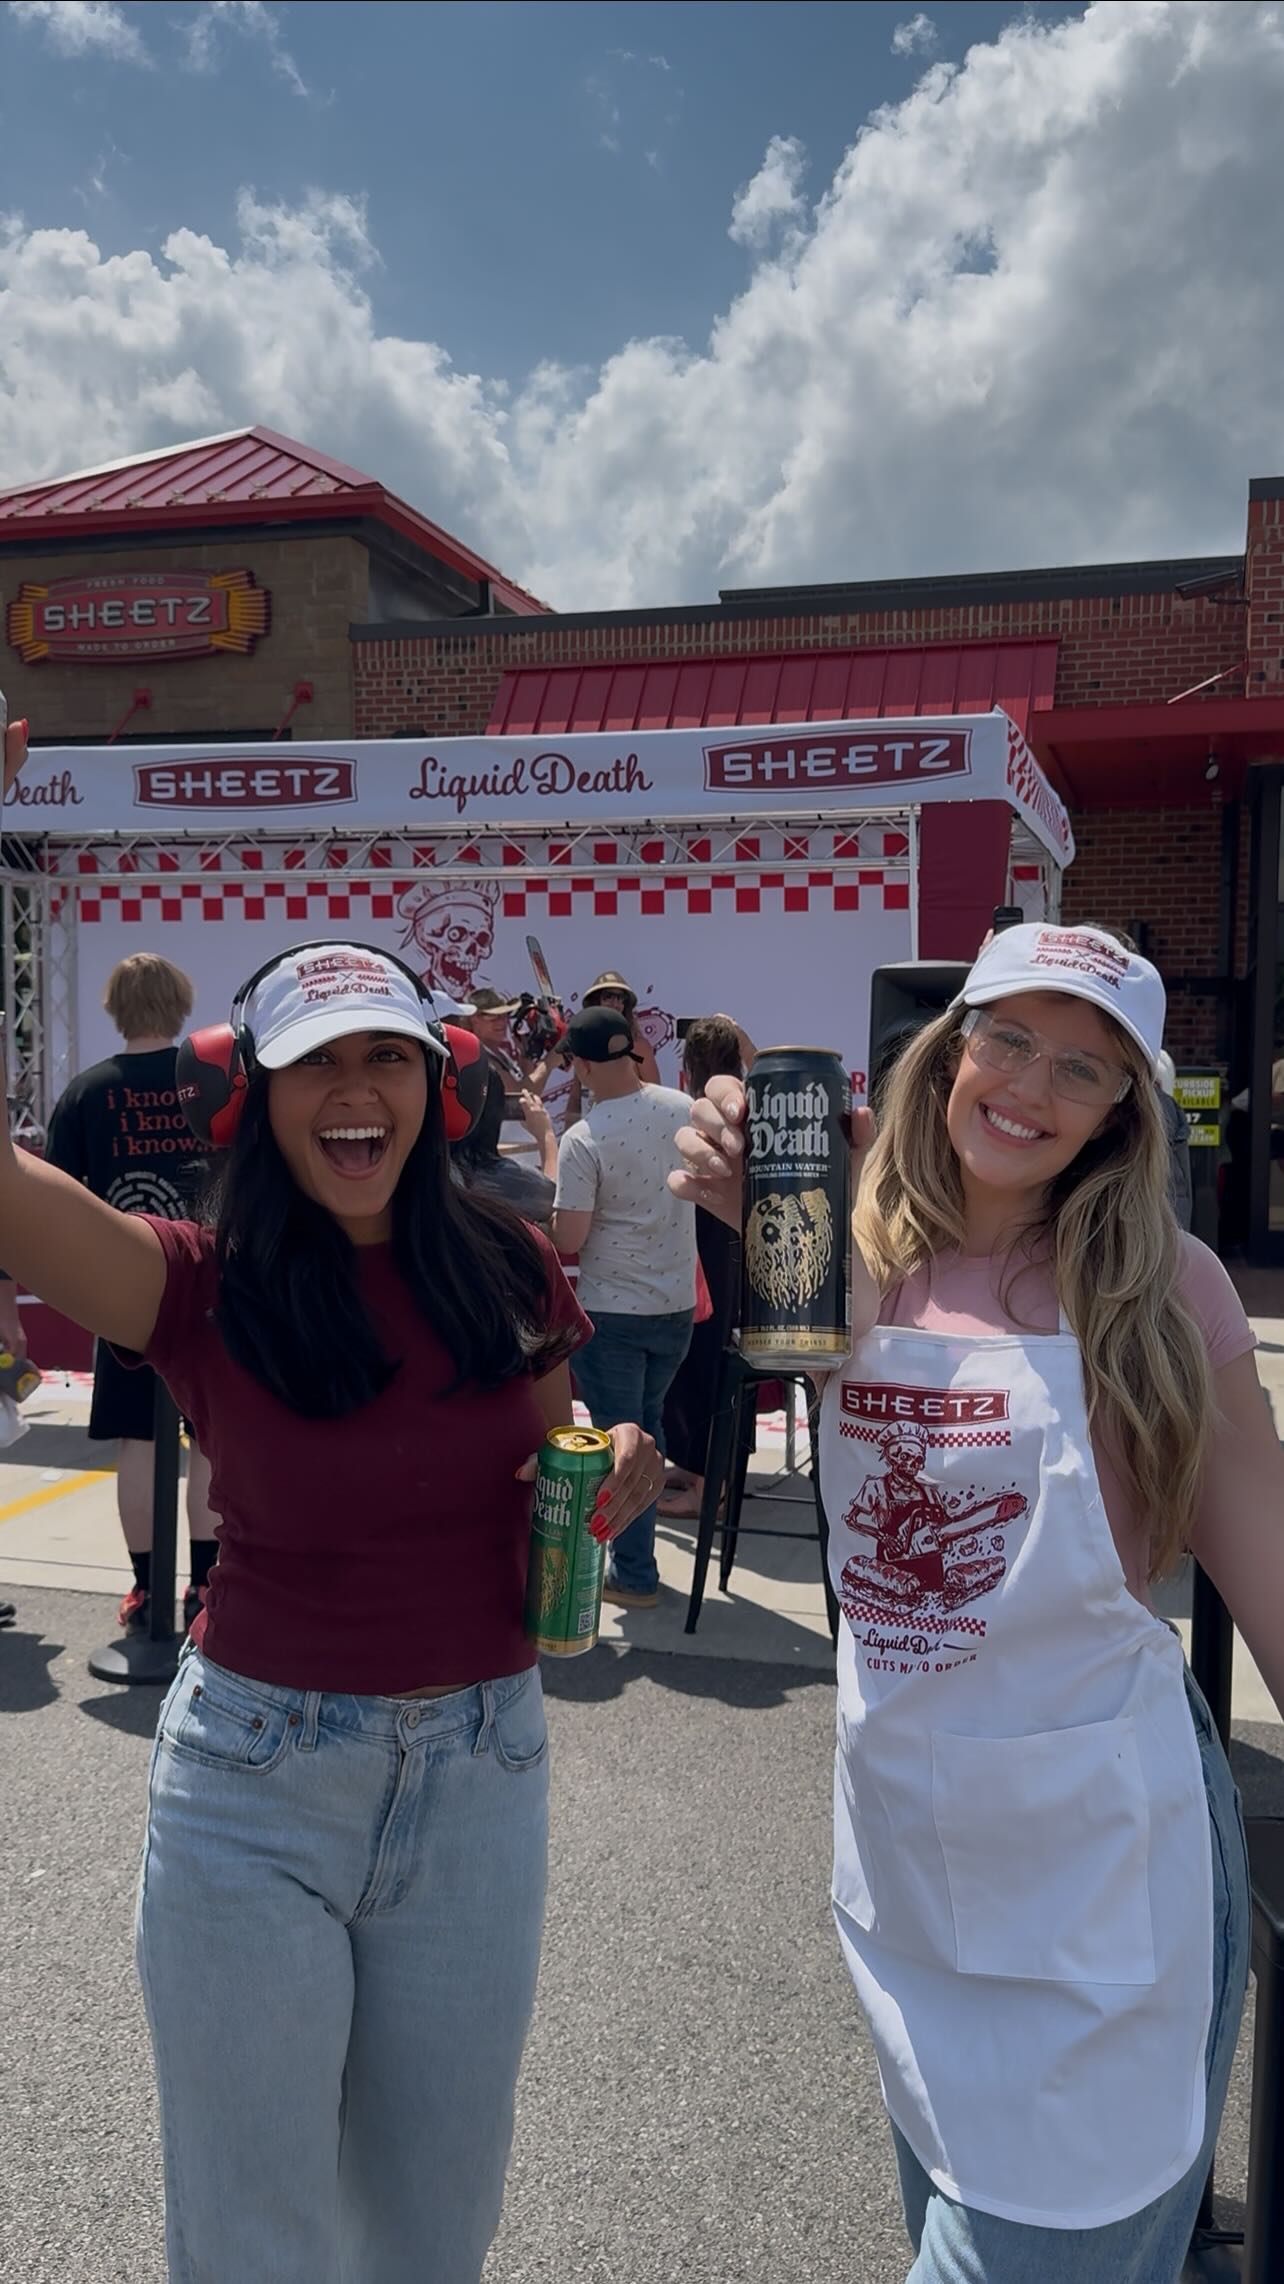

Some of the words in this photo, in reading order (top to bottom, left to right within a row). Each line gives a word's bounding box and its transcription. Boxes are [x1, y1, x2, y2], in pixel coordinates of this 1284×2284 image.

[44, 596, 212, 632] SHEETZ
[723, 738, 951, 783] SHEETZ
[150, 767, 341, 799] SHEETZ
[409, 756, 530, 814] Liquid
[530, 752, 654, 795] Death
[1030, 954, 1080, 969] Liquid
[1079, 962, 1121, 990] Death
[304, 984, 350, 1003] Liquid
[350, 982, 394, 998] Death
[107, 1089, 116, 1110] i
[123, 1087, 176, 1108] kno
[748, 1081, 829, 1130] Liquid
[120, 1111, 128, 1133] i
[136, 1111, 187, 1132] kno
[112, 1136, 119, 1157] i
[750, 1120, 830, 1159] Death
[846, 1388, 995, 1418] SHEETZ
[537, 1464, 574, 1501] iquid
[862, 1628, 911, 1656] Liquid
[867, 1658, 895, 1672] CUTS
